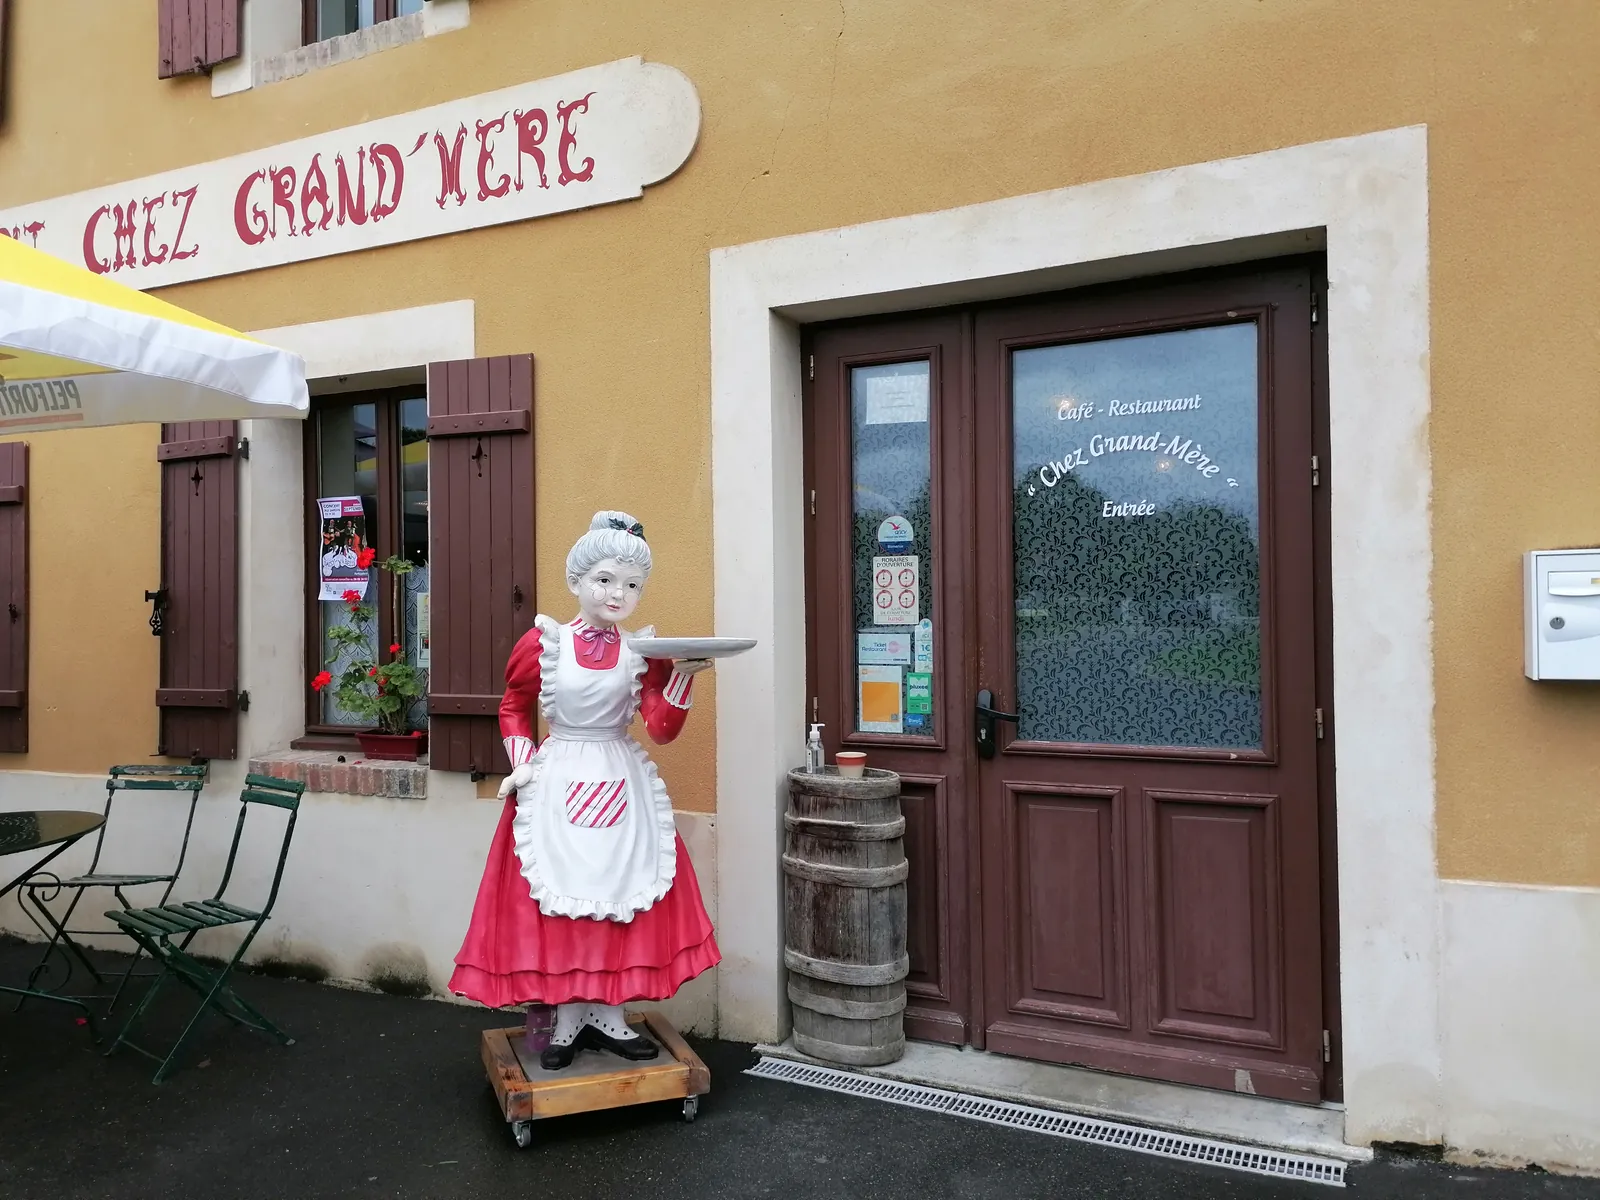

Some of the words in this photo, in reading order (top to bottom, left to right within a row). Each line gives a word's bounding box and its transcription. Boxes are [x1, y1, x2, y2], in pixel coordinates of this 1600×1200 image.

[82, 184, 200, 275] CHEZ
[1057, 399, 1094, 422] Café
[1108, 394, 1202, 417] Restaurant
[1039, 447, 1089, 488] Chez
[1089, 431, 1221, 479] Grand-Mère
[1102, 499, 1156, 518] Entrée
